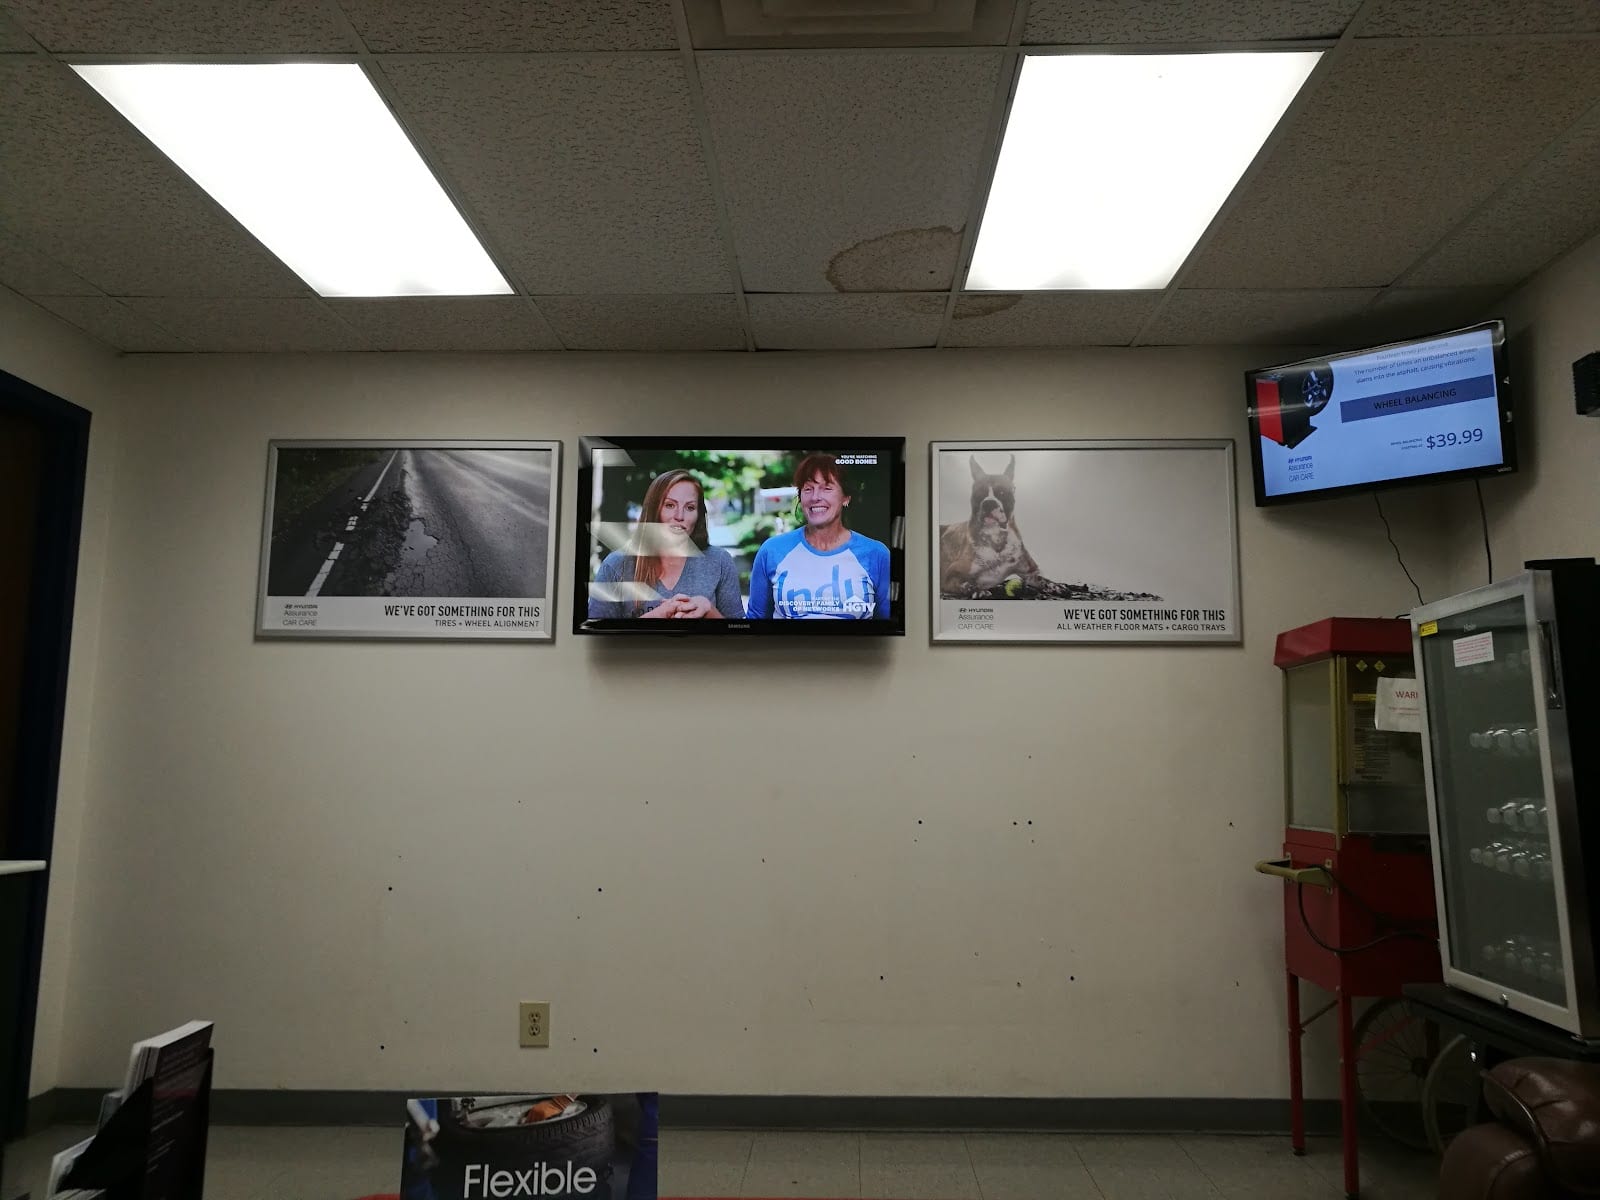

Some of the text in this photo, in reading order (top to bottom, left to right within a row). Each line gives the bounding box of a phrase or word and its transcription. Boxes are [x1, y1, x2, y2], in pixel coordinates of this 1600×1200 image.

[1365, 365, 1388, 374] number
[1422, 350, 1458, 362] unbalanced
[1420, 363, 1443, 374] causing
[1373, 388, 1457, 409] WHEEL BALANCING
[1426, 428, 1483, 450] $39.99
[384, 605, 540, 617] WE'VE GOT SOMETHING FOR THIS
[843, 602, 876, 612] HGTV
[1064, 609, 1225, 620] WE'VE GOT SOMETHING FOR THIS
[464, 1160, 597, 1198] Flexible
